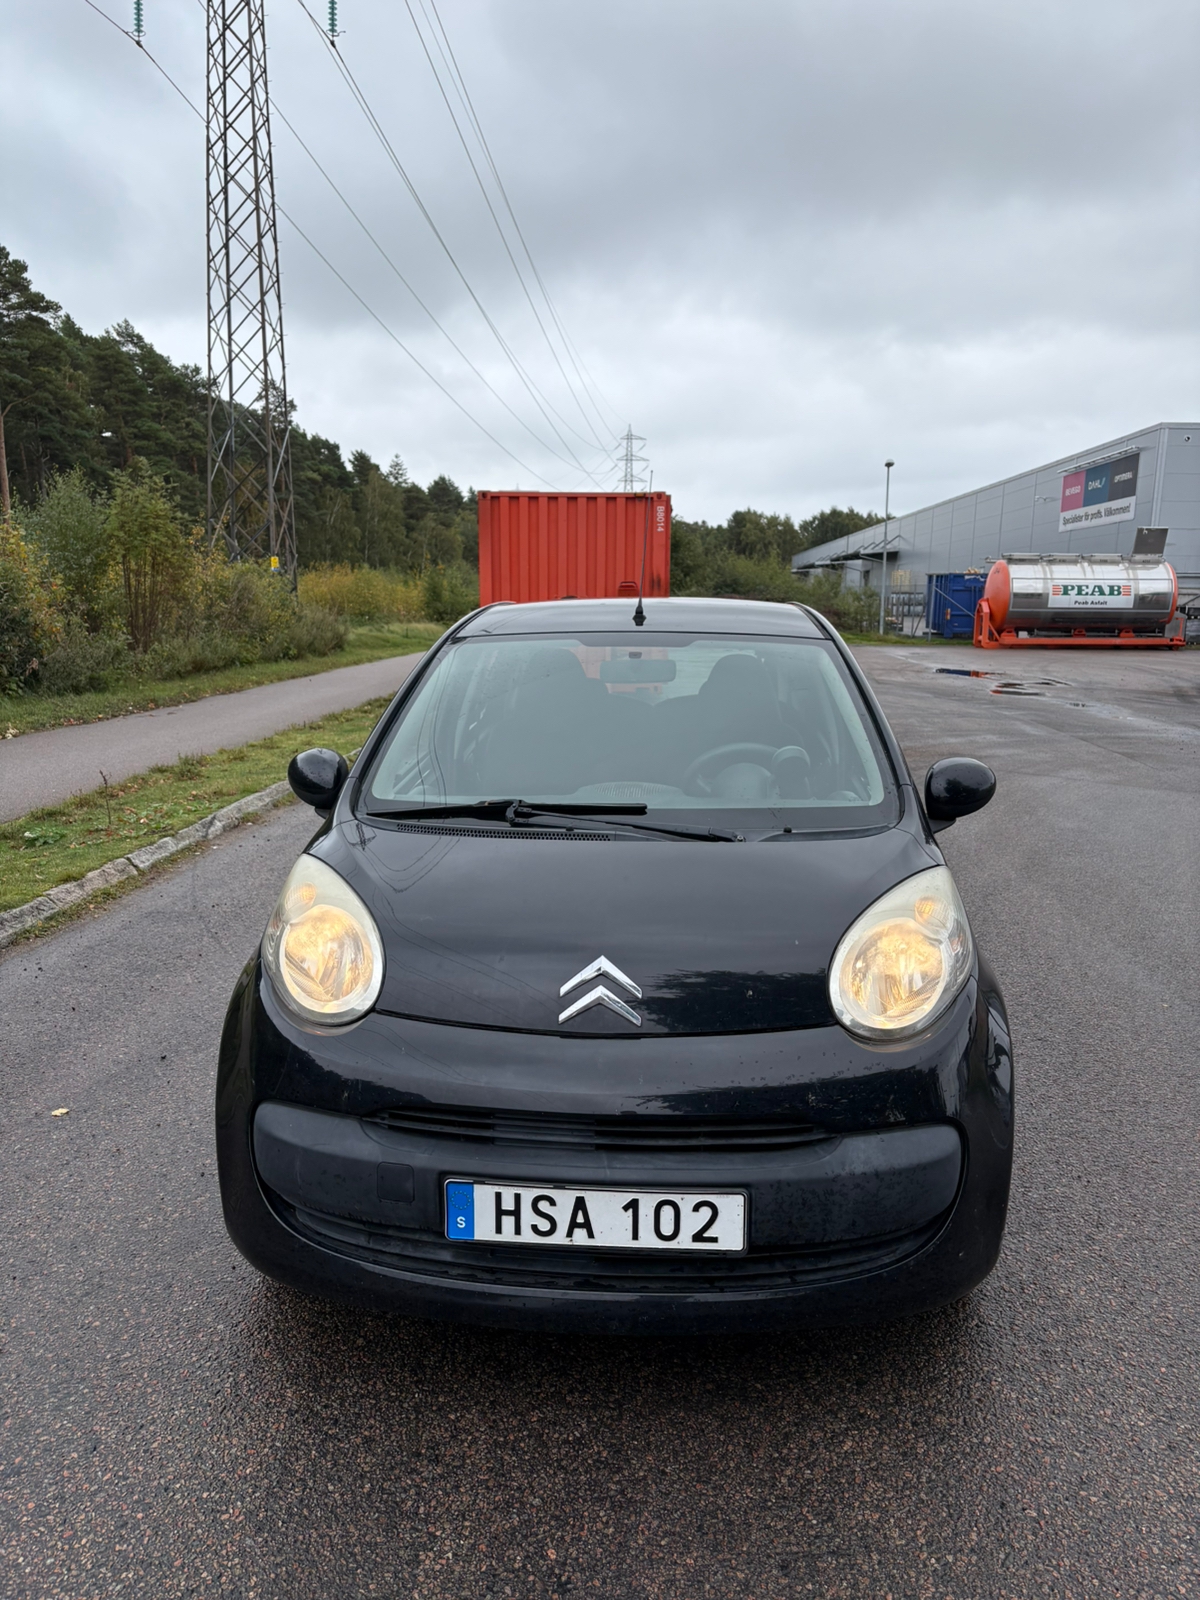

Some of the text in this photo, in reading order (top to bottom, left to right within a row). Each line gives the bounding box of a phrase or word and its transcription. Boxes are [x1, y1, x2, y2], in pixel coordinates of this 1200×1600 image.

[1088, 479, 1102, 490] DAHL
[1065, 485, 1081, 496] BEVEGO
[1061, 585, 1122, 596] PEAB
[456, 1216, 466, 1228] S
[494, 1191, 719, 1243] HSA 102
